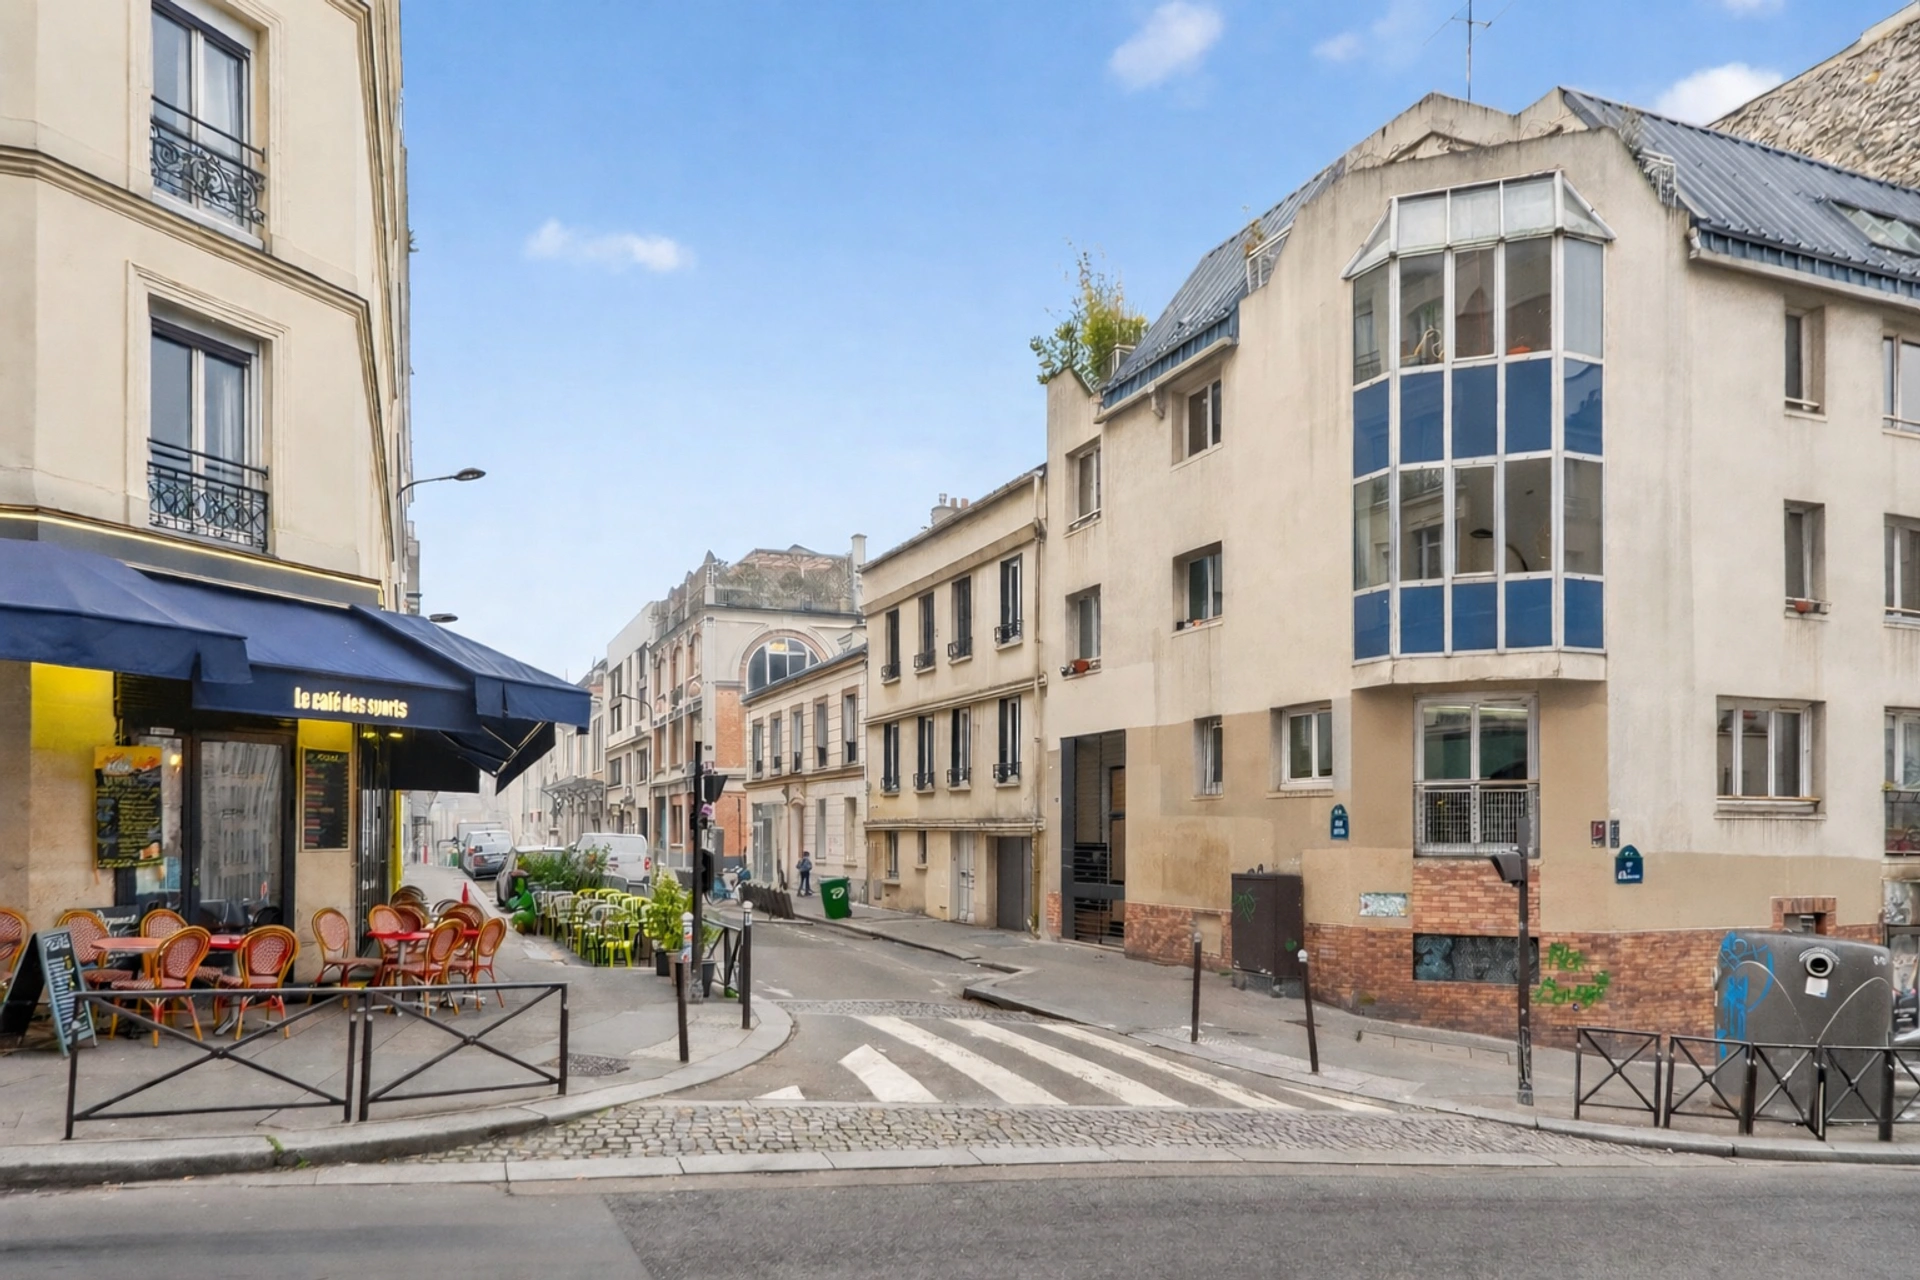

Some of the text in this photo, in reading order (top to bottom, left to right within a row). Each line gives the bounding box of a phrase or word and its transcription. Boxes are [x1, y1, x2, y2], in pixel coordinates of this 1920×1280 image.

[312, 691, 341, 712] café
[342, 693, 366, 714] des
[367, 698, 408, 719] sports
